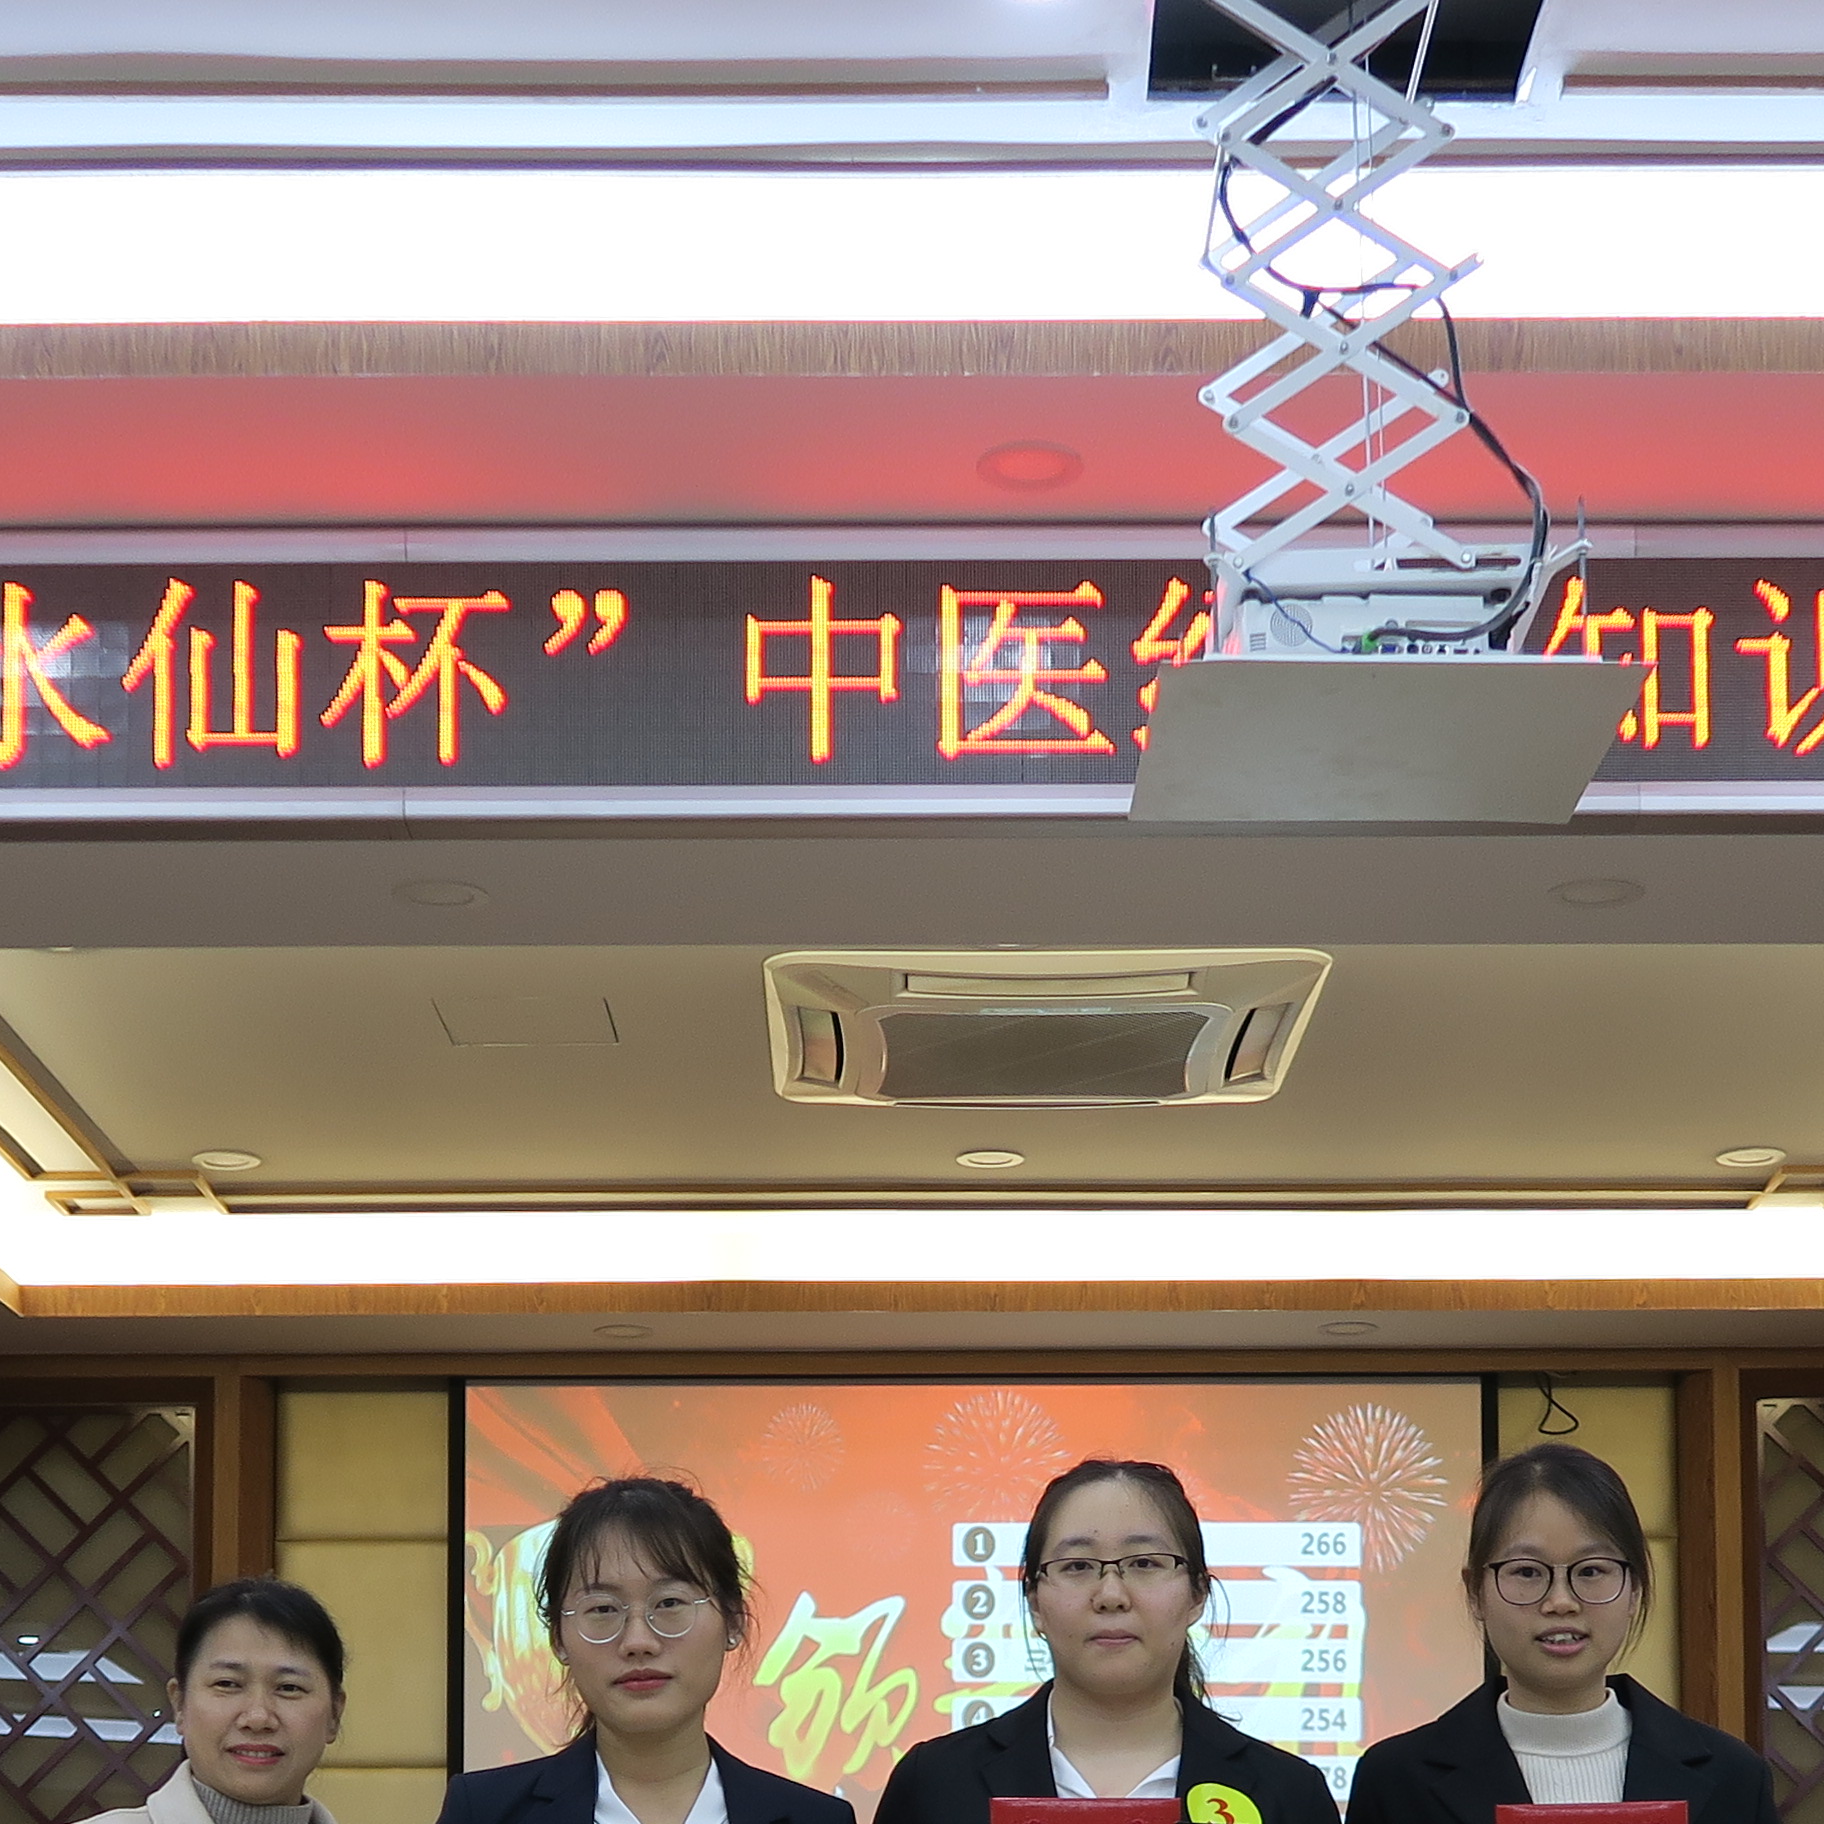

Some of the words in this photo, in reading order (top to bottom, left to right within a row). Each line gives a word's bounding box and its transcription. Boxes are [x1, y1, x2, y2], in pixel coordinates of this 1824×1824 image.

[1300, 1532, 1347, 1556] 266
[1300, 1591, 1347, 1614] 258
[1300, 1649, 1347, 1672] 256
[1300, 1707, 1347, 1731] 254
